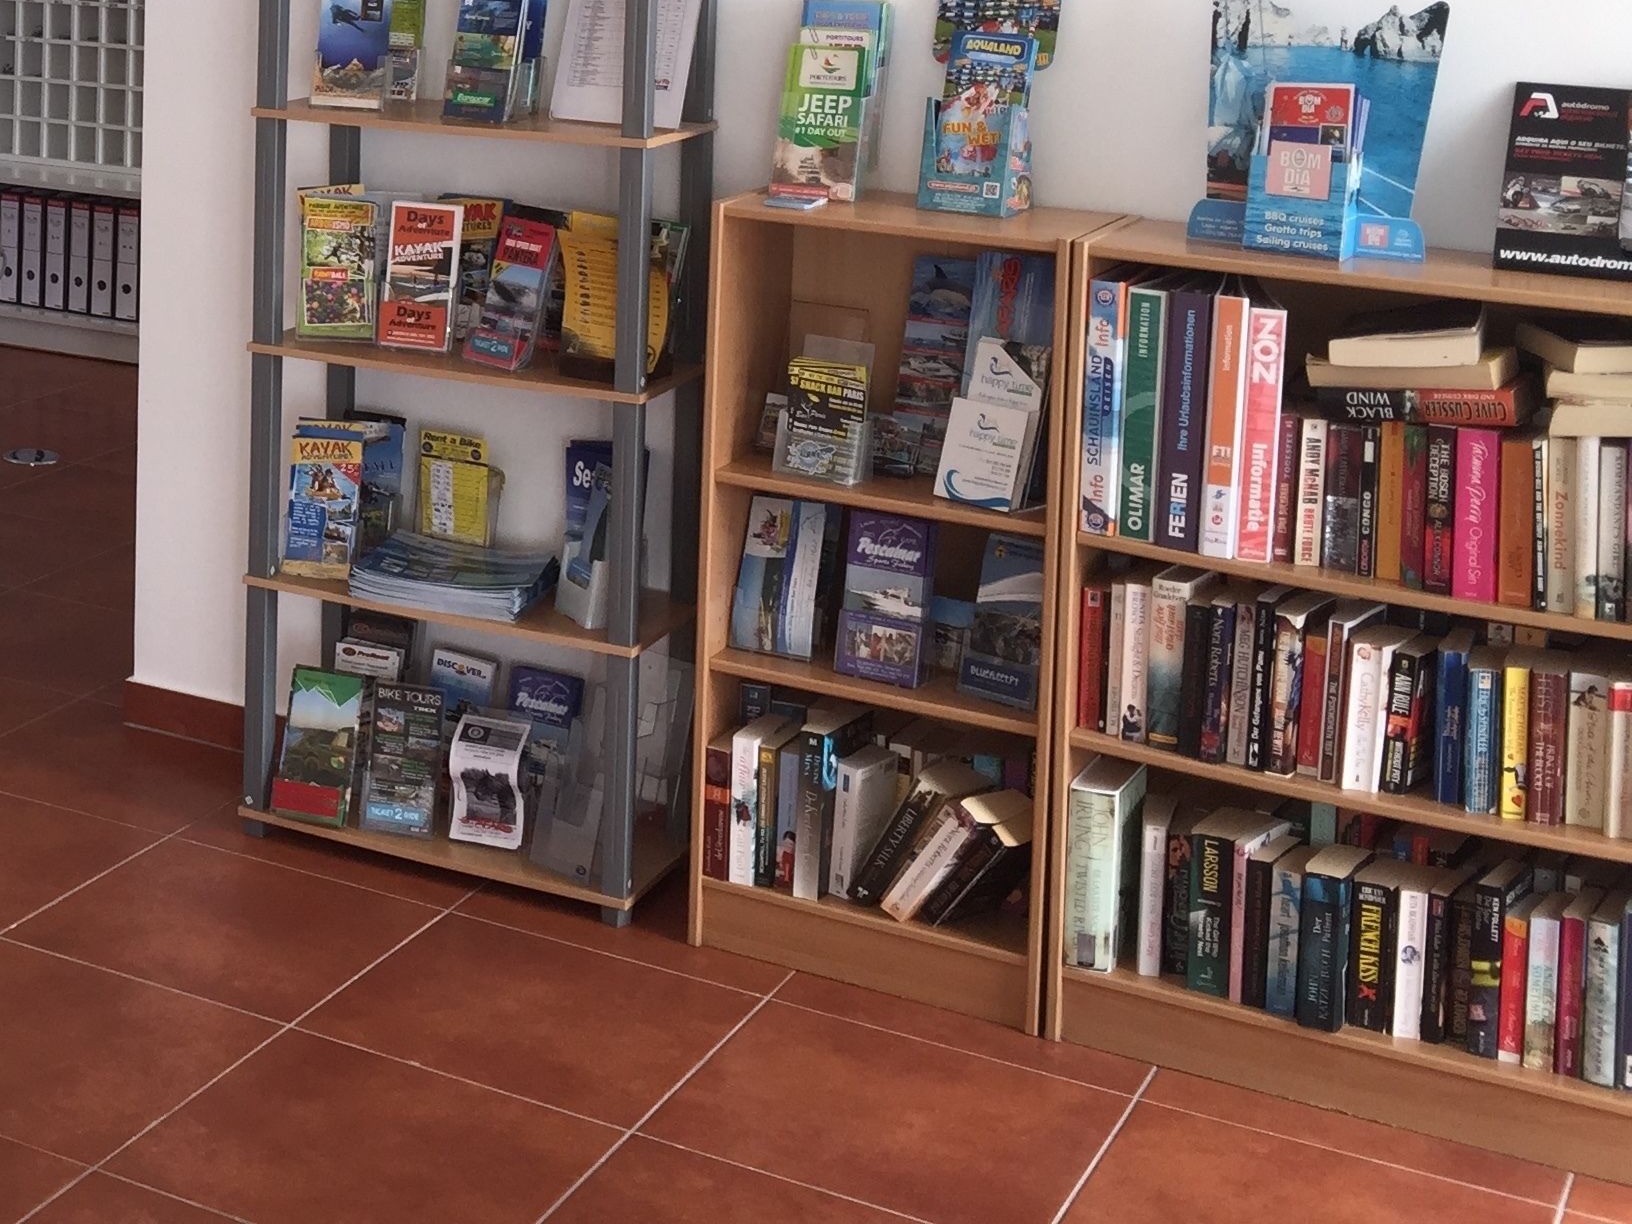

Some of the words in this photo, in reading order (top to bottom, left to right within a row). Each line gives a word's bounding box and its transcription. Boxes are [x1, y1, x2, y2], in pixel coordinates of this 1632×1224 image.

[965, 38, 1022, 56] AQUALAND
[797, 93, 853, 114] JEEP
[796, 112, 849, 127] SAFARI
[942, 121, 973, 135] FUN
[975, 121, 988, 134] &
[794, 127, 805, 135] #1
[806, 127, 825, 136] DAY
[826, 128, 847, 137] OUT
[1279, 147, 1322, 170] BOM
[406, 210, 445, 229] Days
[1264, 210, 1286, 223] BBQ
[1287, 213, 1325, 226] cruises
[397, 224, 451, 237] Adventure
[1264, 223, 1296, 236] Grotto
[1298, 226, 1323, 239] trips
[394, 241, 445, 256] KAYAK
[1256, 235, 1290, 251] Sailing
[1291, 240, 1329, 252] cruises
[391, 253, 445, 263] ADVENTURE
[388, 319, 437, 331] Adventure
[396, 305, 432, 322] Days
[1095, 319, 1110, 348] Info
[1138, 301, 1151, 358] INFORMATION
[1222, 324, 1234, 372] Information
[799, 379, 826, 394] SNACK
[827, 384, 842, 396] BAR
[843, 386, 865, 401] PARIS
[980, 375, 1009, 394] happy
[1345, 391, 1391, 405] WIND
[1423, 400, 1471, 419] CUSSLER
[1087, 354, 1103, 466] SCHAUINSLAND
[1345, 405, 1394, 419] BLACK
[1472, 401, 1507, 420] CLIVE
[299, 441, 353, 456] KAYAK
[423, 432, 444, 444] Rent
[447, 436, 457, 445] a
[459, 436, 482, 450] Bike
[968, 429, 996, 448] happy
[1177, 429, 1189, 451] Ihre
[1306, 437, 1321, 465] ANDY
[1439, 443, 1451, 466] THE
[573, 460, 594, 488] Se
[1428, 443, 1440, 500] DECEPTION
[1090, 473, 1104, 504] Info
[1127, 462, 1146, 531] OLIMAR
[1246, 443, 1268, 533] Informatie
[1438, 467, 1449, 503] BOSCH
[1168, 472, 1189, 539] FERIEN
[1361, 490, 1373, 535] CONGO
[1302, 508, 1316, 534] BRUTE
[1553, 490, 1569, 571] Zonnekind
[1300, 536, 1313, 563] FORCE
[1465, 526, 1483, 568] Original
[1467, 569, 1481, 585] Sin
[1210, 616, 1225, 645] Nora
[1208, 645, 1222, 688] Roberts
[1232, 650, 1249, 715] HUTCHINSON
[1329, 680, 1338, 694] THE
[1394, 672, 1412, 694] ANN
[377, 687, 402, 703] BIKE
[404, 690, 441, 707] TOURS
[1391, 693, 1411, 716] RULE
[1324, 740, 1334, 757] TEST
[394, 807, 403, 822] 2
[1074, 798, 1093, 850] IRVING
[885, 807, 918, 847] LIBERTY
[1092, 806, 1111, 848] JOHN
[873, 844, 895, 867] SILK
[1202, 839, 1220, 894] LARSSON
[1073, 863, 1089, 914] TWISTED
[1312, 917, 1322, 934] Der
[1359, 903, 1382, 953] FRENCH
[1490, 912, 1500, 943] FOLLETT
[1358, 953, 1379, 984] KISS
